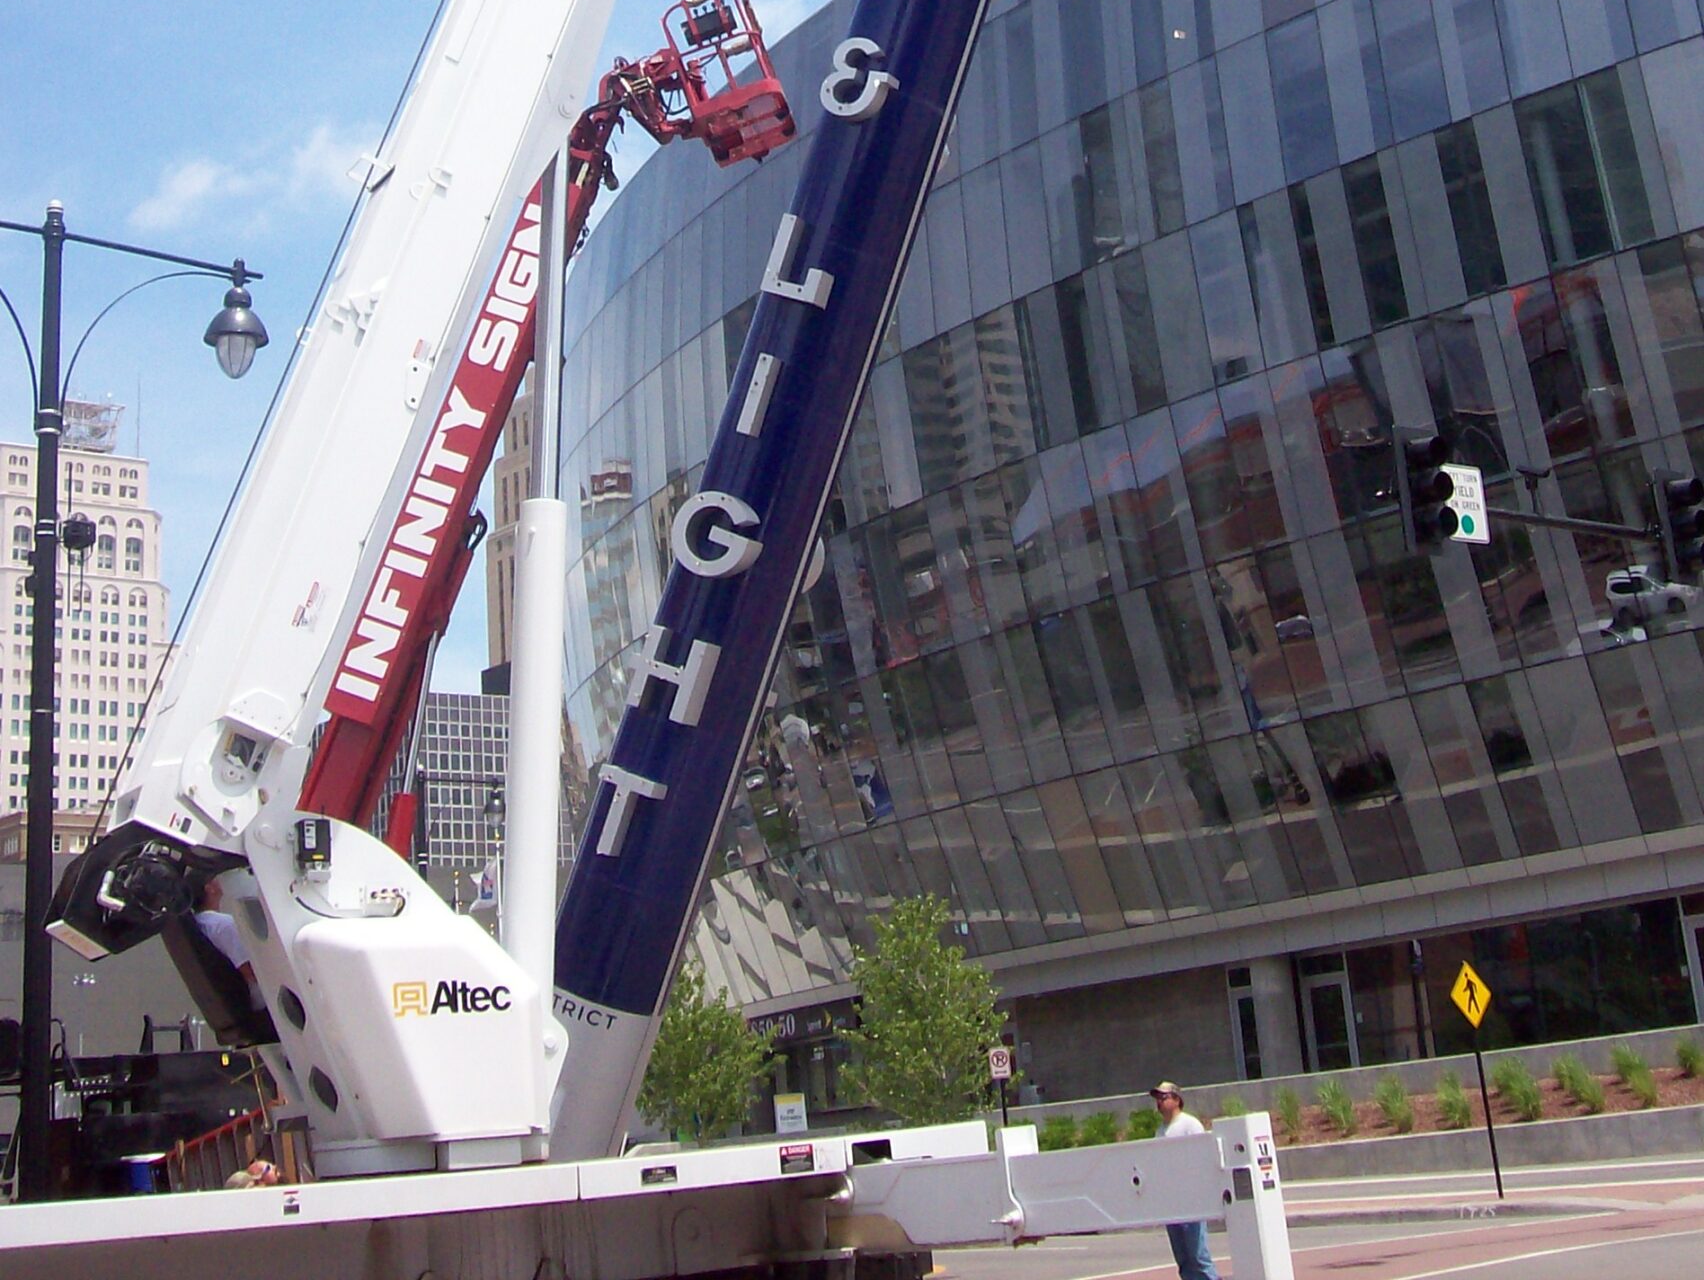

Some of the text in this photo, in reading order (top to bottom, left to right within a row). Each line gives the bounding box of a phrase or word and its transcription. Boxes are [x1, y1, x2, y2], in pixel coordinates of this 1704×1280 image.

[820, 37, 899, 121] &
[1454, 484, 1475, 498] YIELD
[335, 384, 487, 703] INFINITY
[596, 213, 835, 857] LIGHT
[430, 980, 512, 1014] Altec
